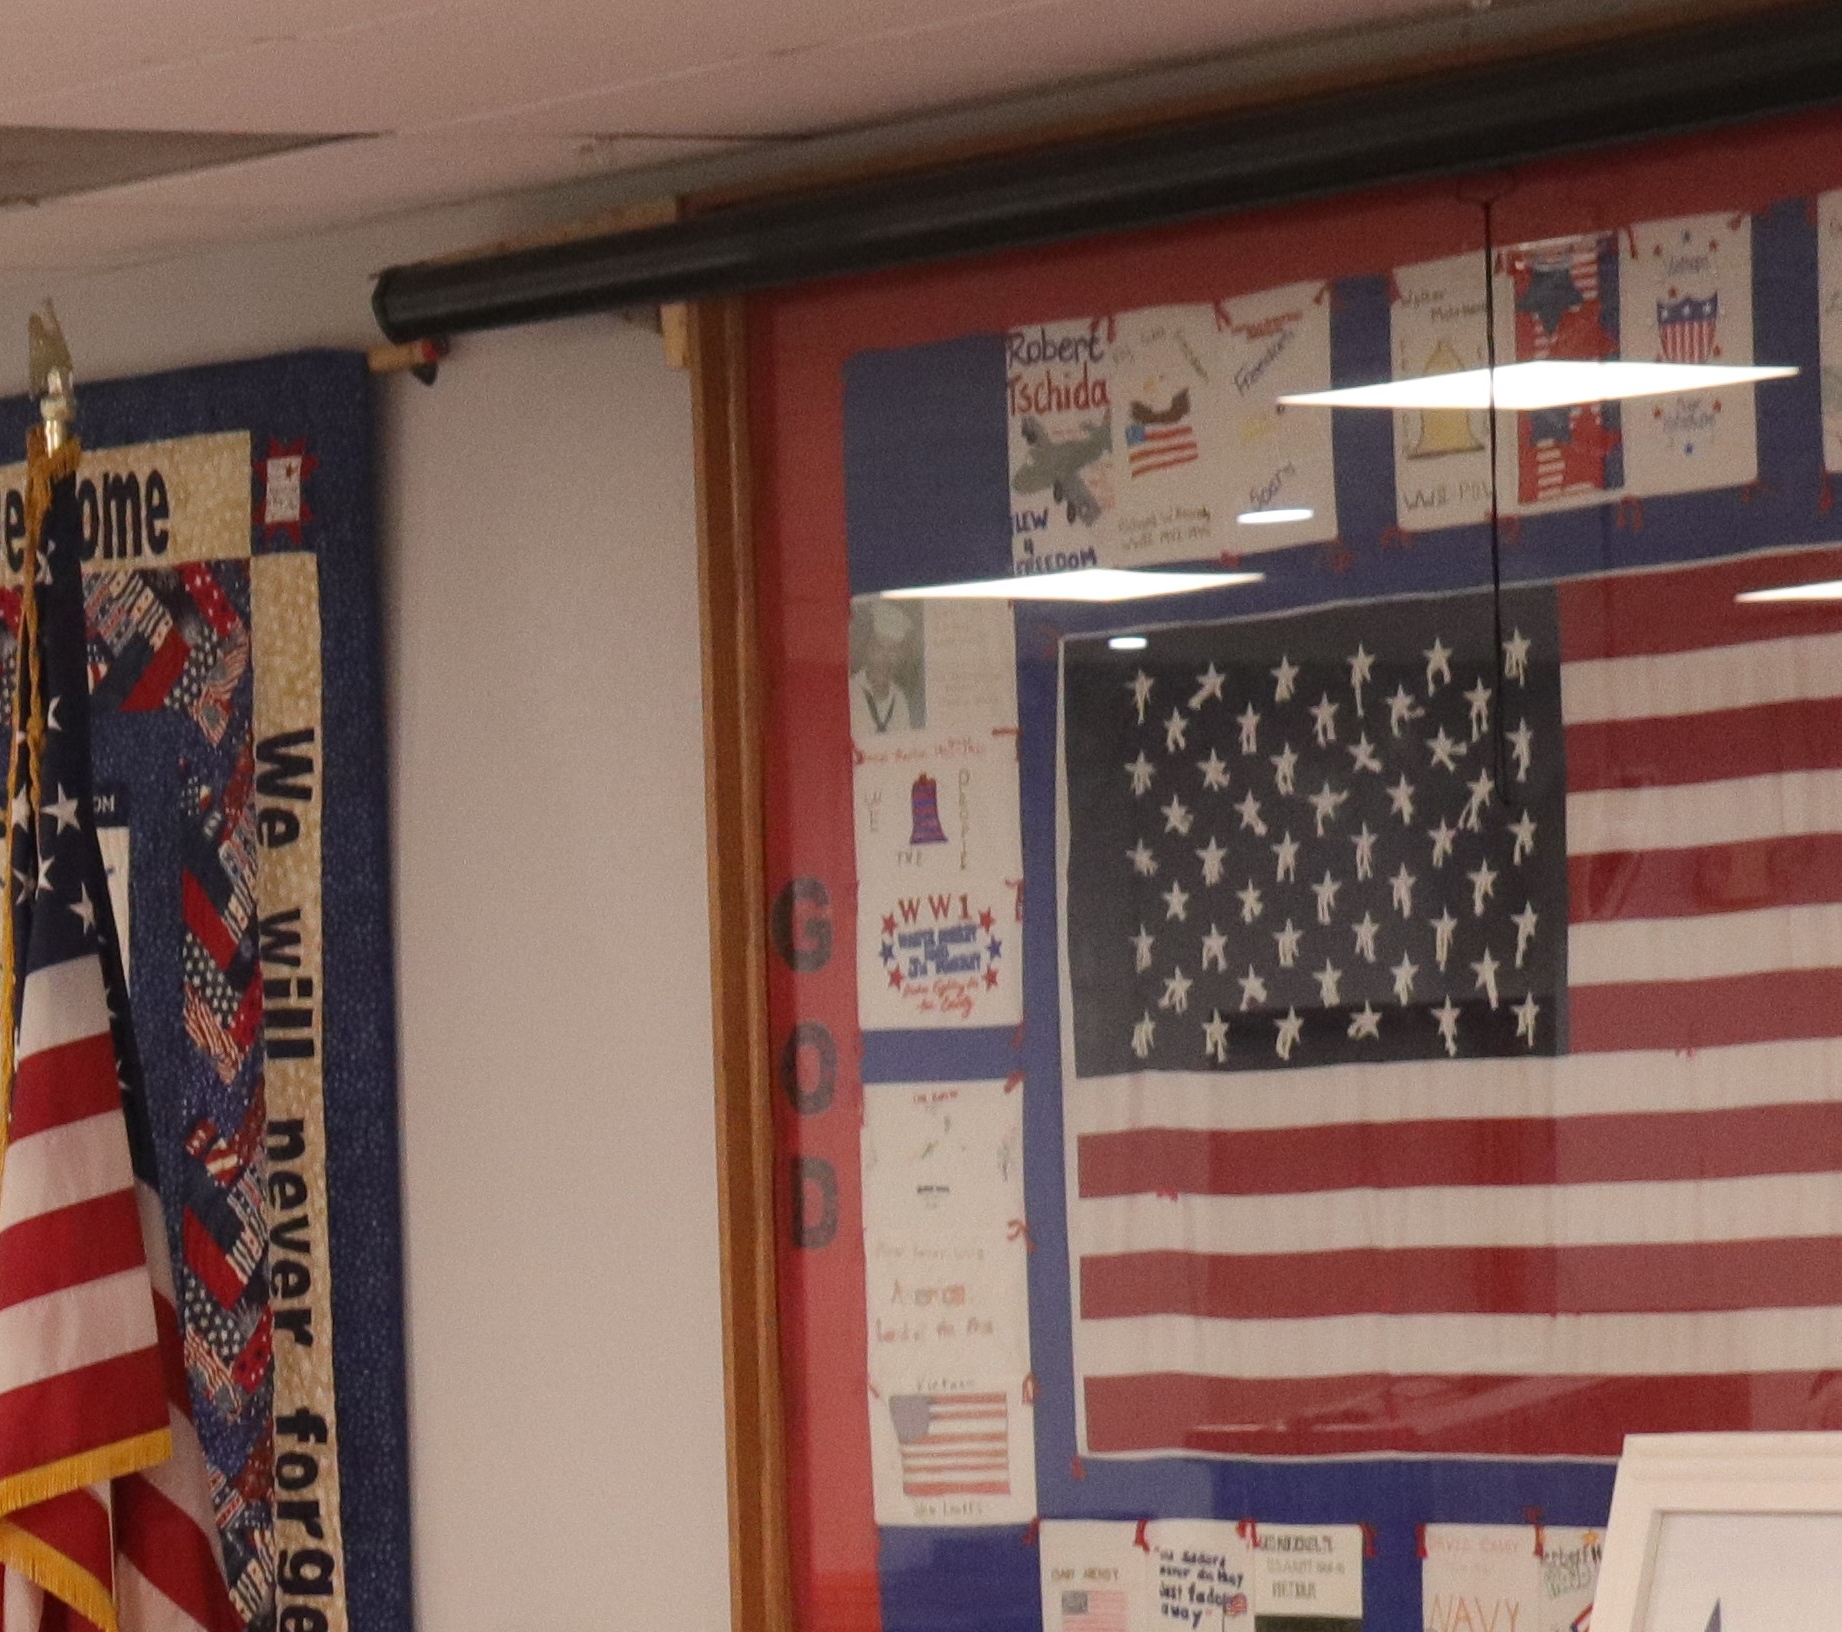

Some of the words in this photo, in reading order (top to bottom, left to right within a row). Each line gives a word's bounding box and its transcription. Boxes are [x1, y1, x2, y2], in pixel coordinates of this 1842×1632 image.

[1007, 325, 1105, 369] Robert
[1007, 360, 1112, 416] Tschida
[74, 468, 170, 563] ome
[1015, 507, 1049, 533] LEW
[255, 728, 315, 850] We
[258, 907, 315, 1060] will
[265, 1116, 314, 1347] never
